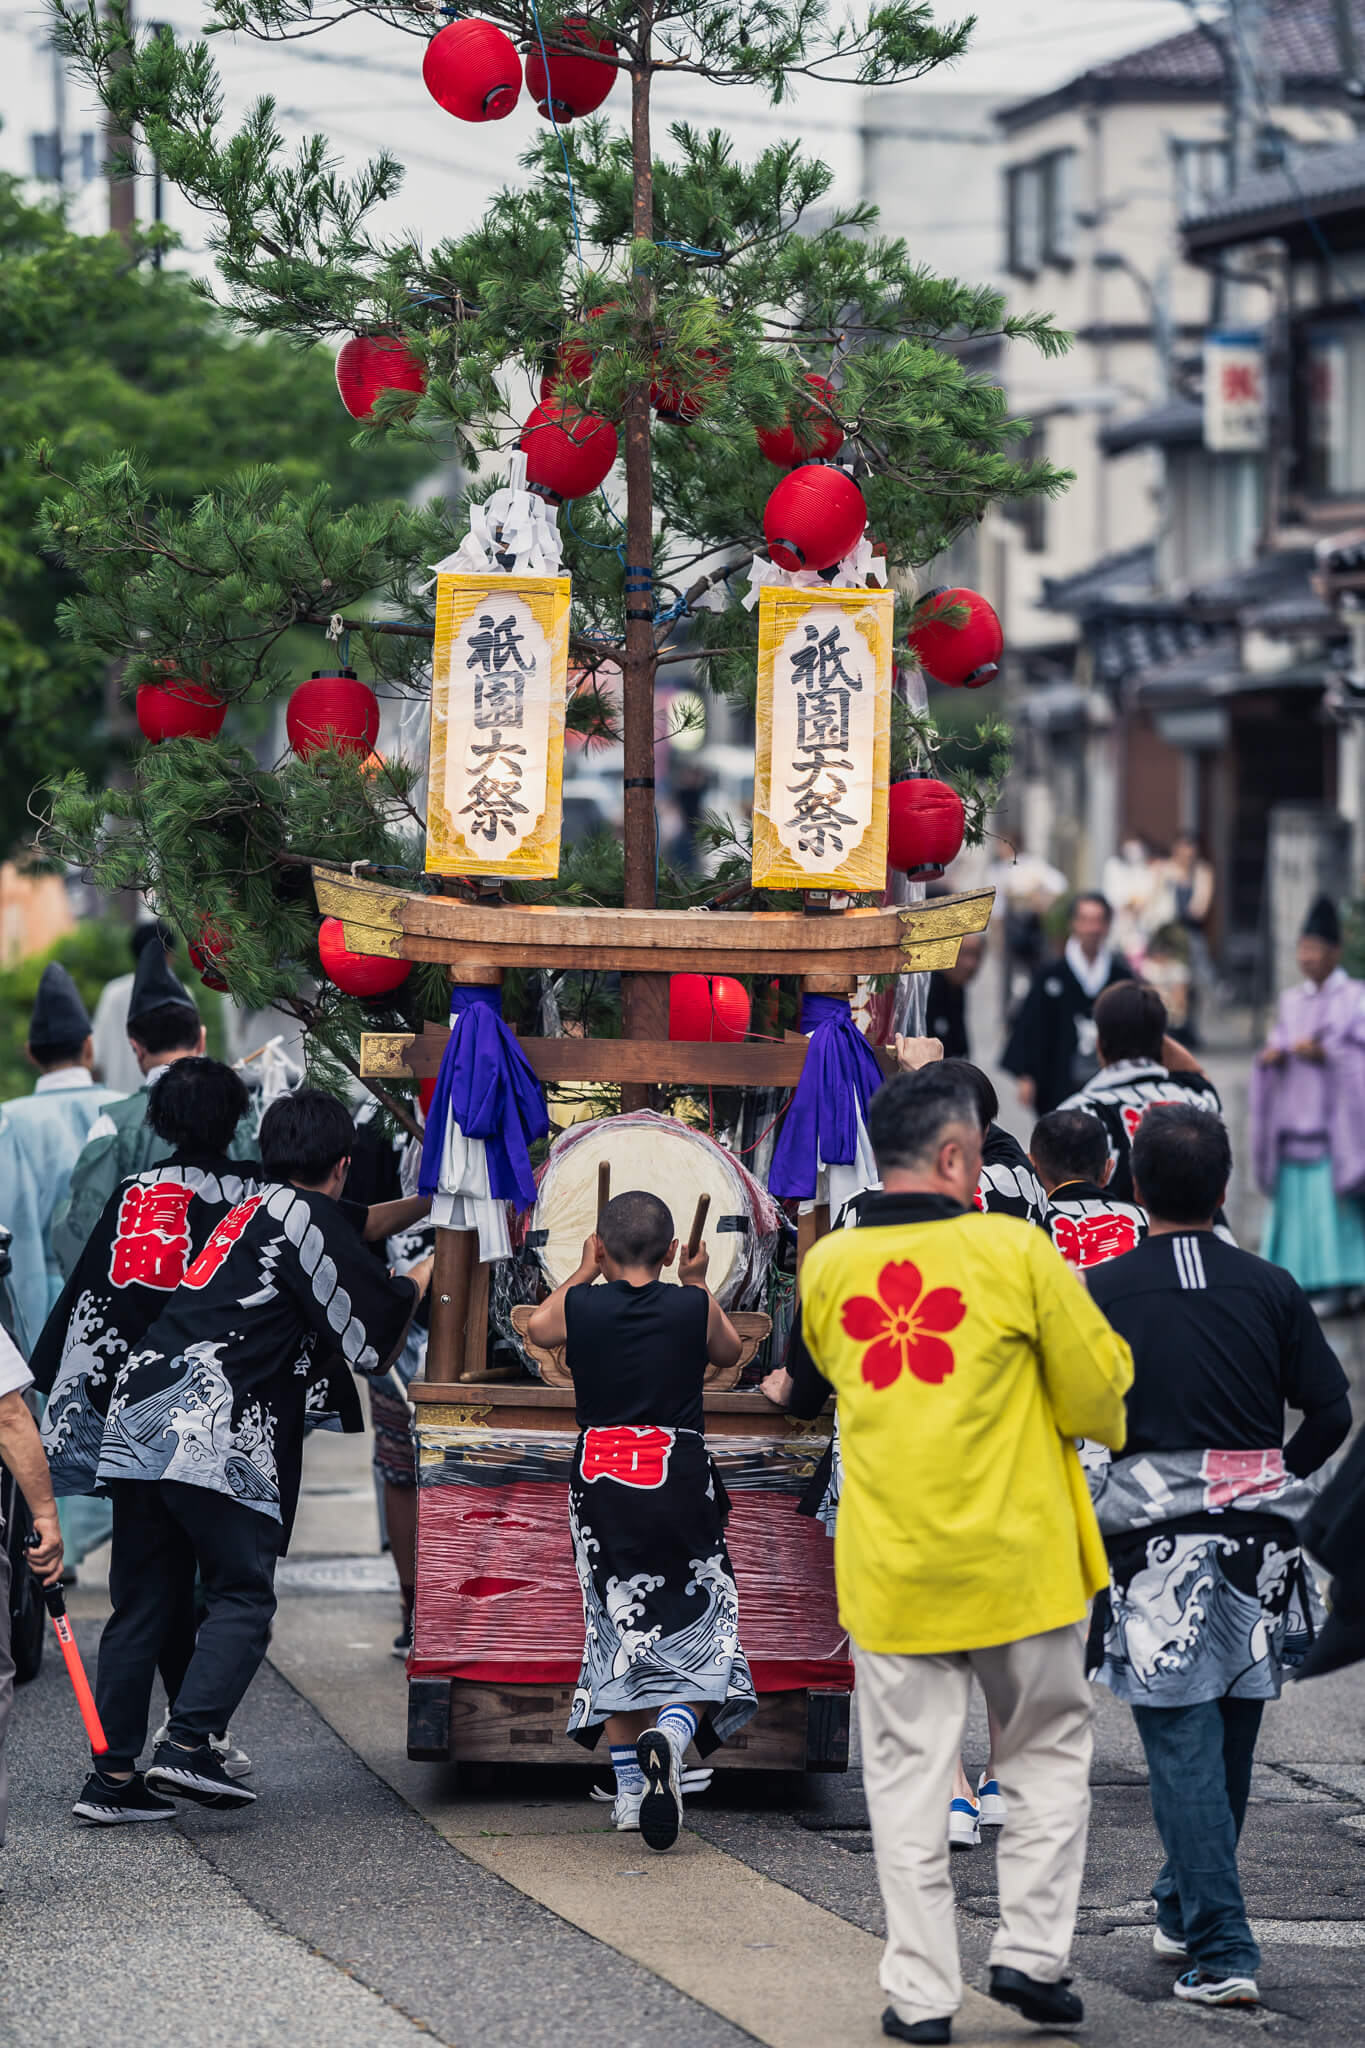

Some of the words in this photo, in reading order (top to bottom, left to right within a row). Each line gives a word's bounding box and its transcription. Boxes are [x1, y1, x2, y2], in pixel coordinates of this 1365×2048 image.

[458, 614, 537, 842] 祇園大祭
[784, 624, 863, 858] 祇園大祭
